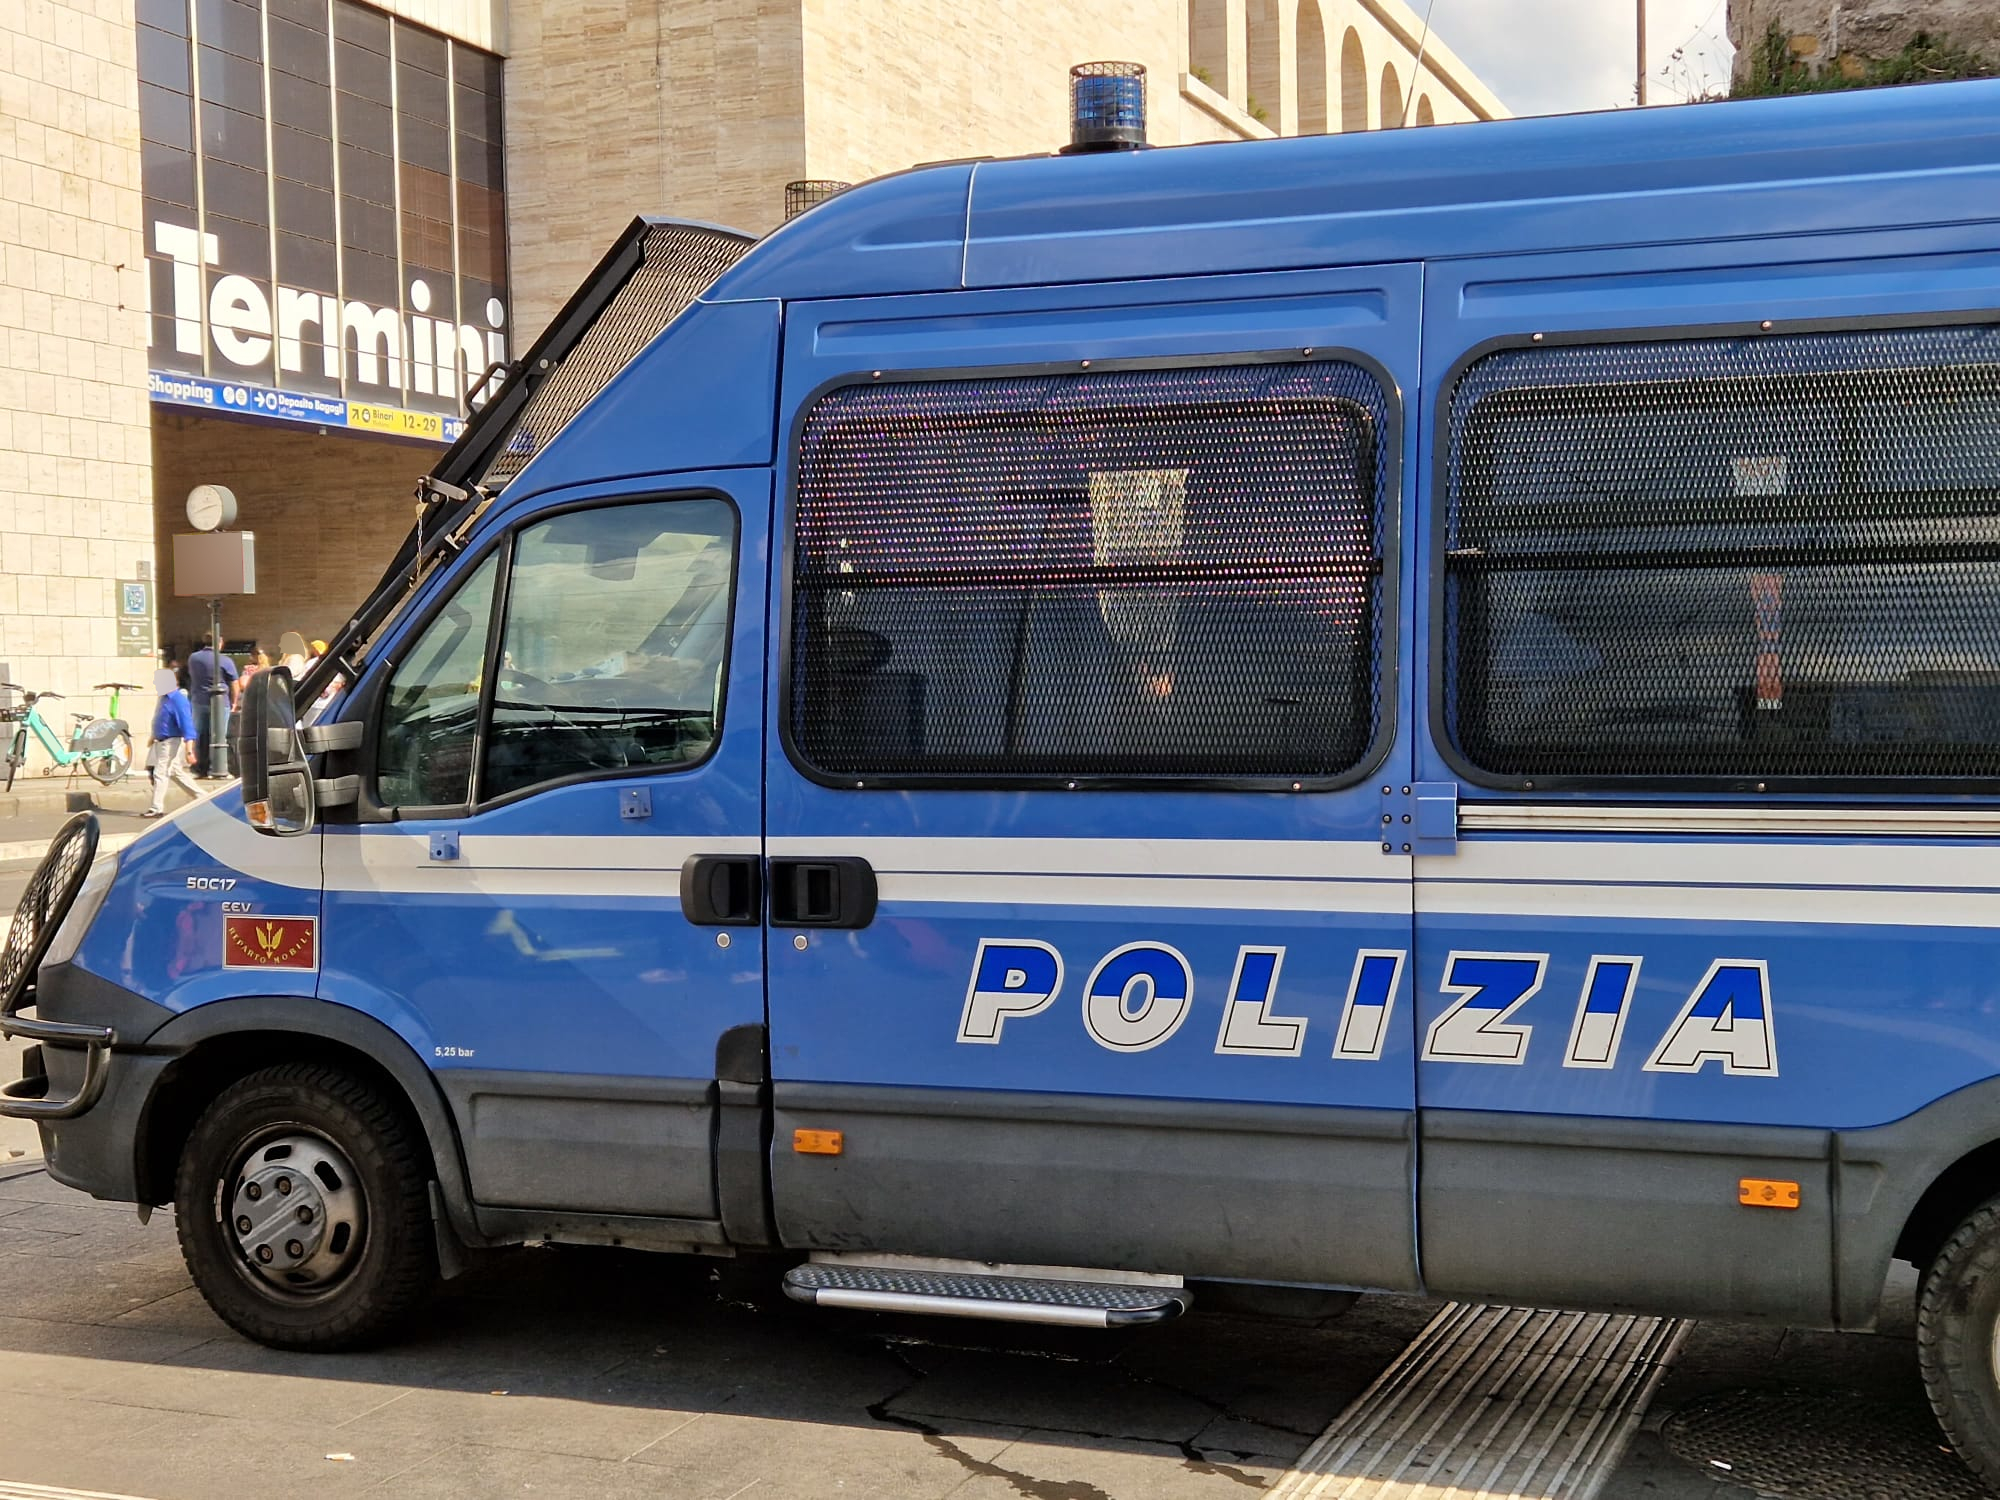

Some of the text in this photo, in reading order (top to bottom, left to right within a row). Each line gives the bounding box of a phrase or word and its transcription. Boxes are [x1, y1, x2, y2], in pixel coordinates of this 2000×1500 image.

[155, 220, 505, 404] Termini
[148, 374, 213, 404] Shopping
[278, 394, 313, 410] Deposito
[372, 409, 394, 421] Binari
[186, 877, 236, 891] 50C17
[221, 901, 251, 912] EEV
[228, 926, 312, 964] REPARTO MOBILE
[956, 937, 1780, 1078] POLIZIA
[435, 1047, 475, 1058] 5,25 bar
